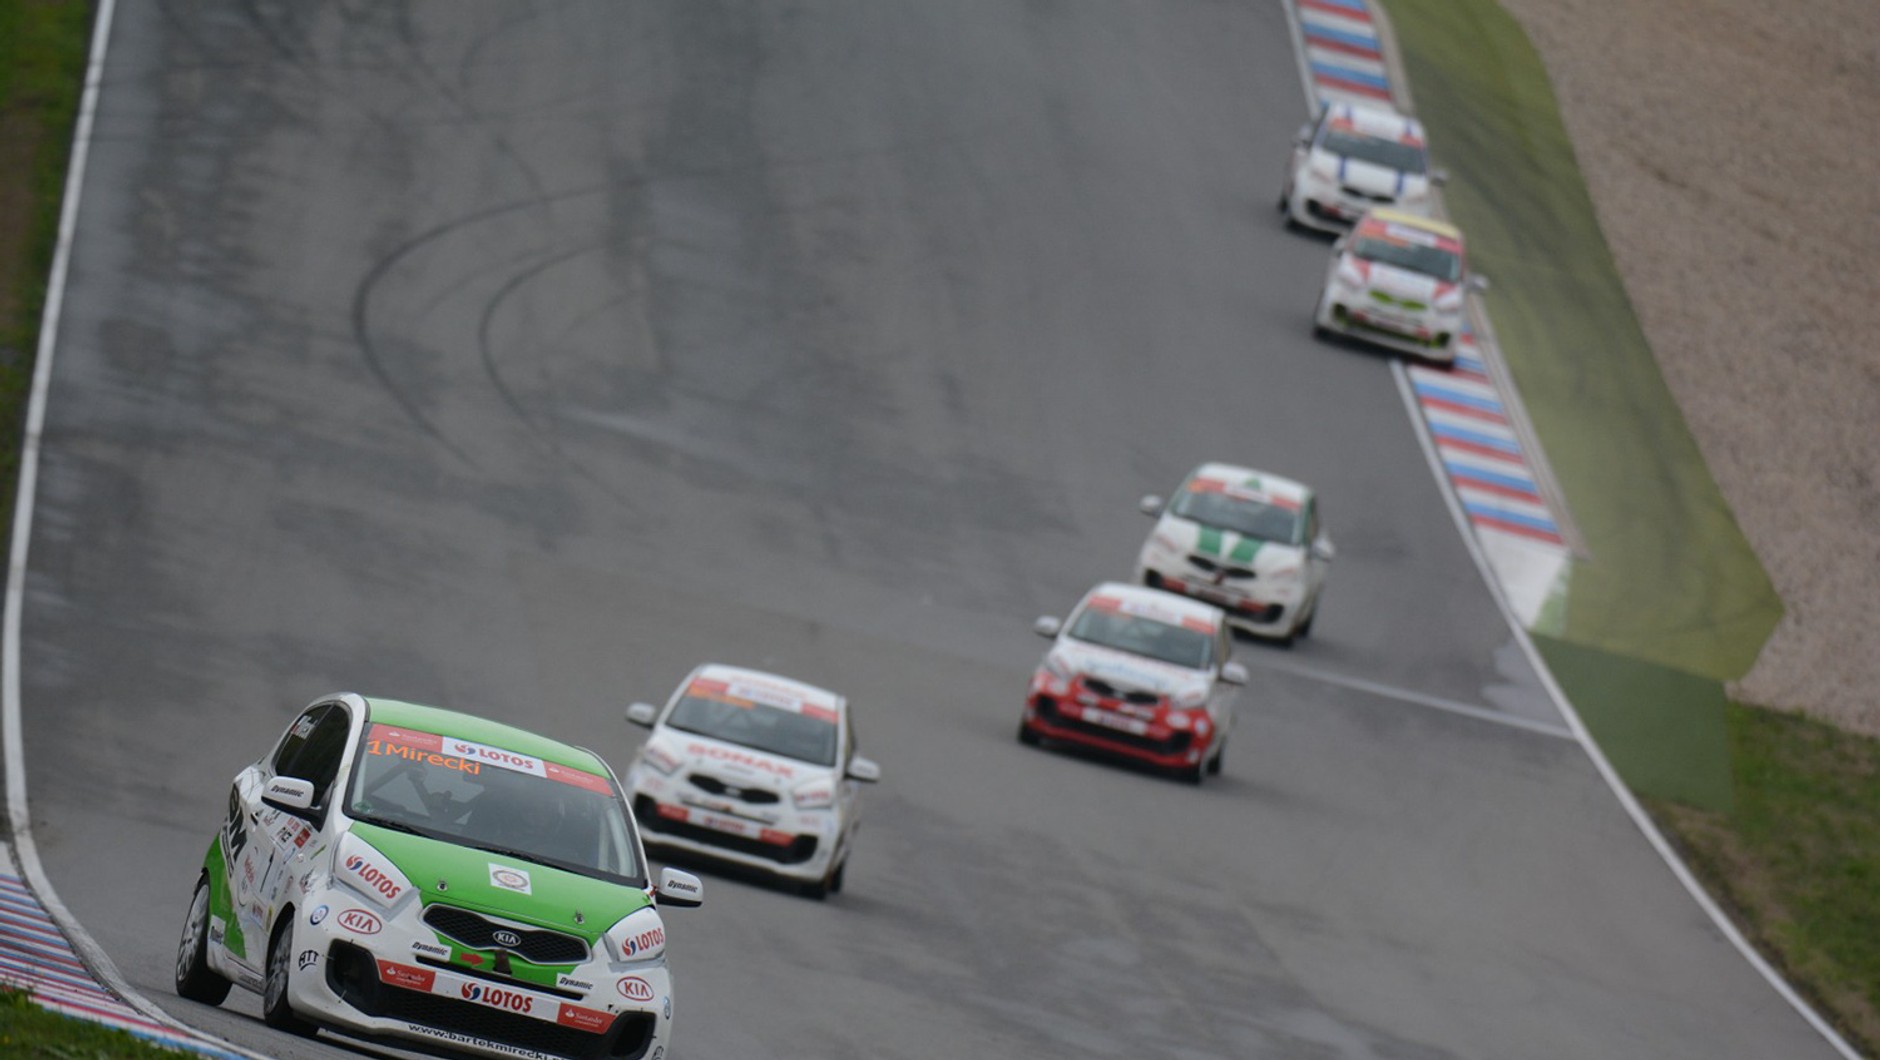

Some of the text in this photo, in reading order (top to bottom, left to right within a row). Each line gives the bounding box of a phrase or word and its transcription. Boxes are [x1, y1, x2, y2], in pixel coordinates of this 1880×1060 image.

[479, 747, 534, 770] LOTOS
[358, 863, 401, 899] LOTOS
[667, 878, 698, 894] Dynamic
[342, 911, 375, 933] KIA
[411, 941, 448, 956] Dynamic
[495, 932, 518, 946] KIA
[635, 927, 664, 951] LOTOS
[559, 977, 593, 990] Dynamic
[622, 980, 651, 999] KIA
[482, 986, 533, 1013] LOTOS
